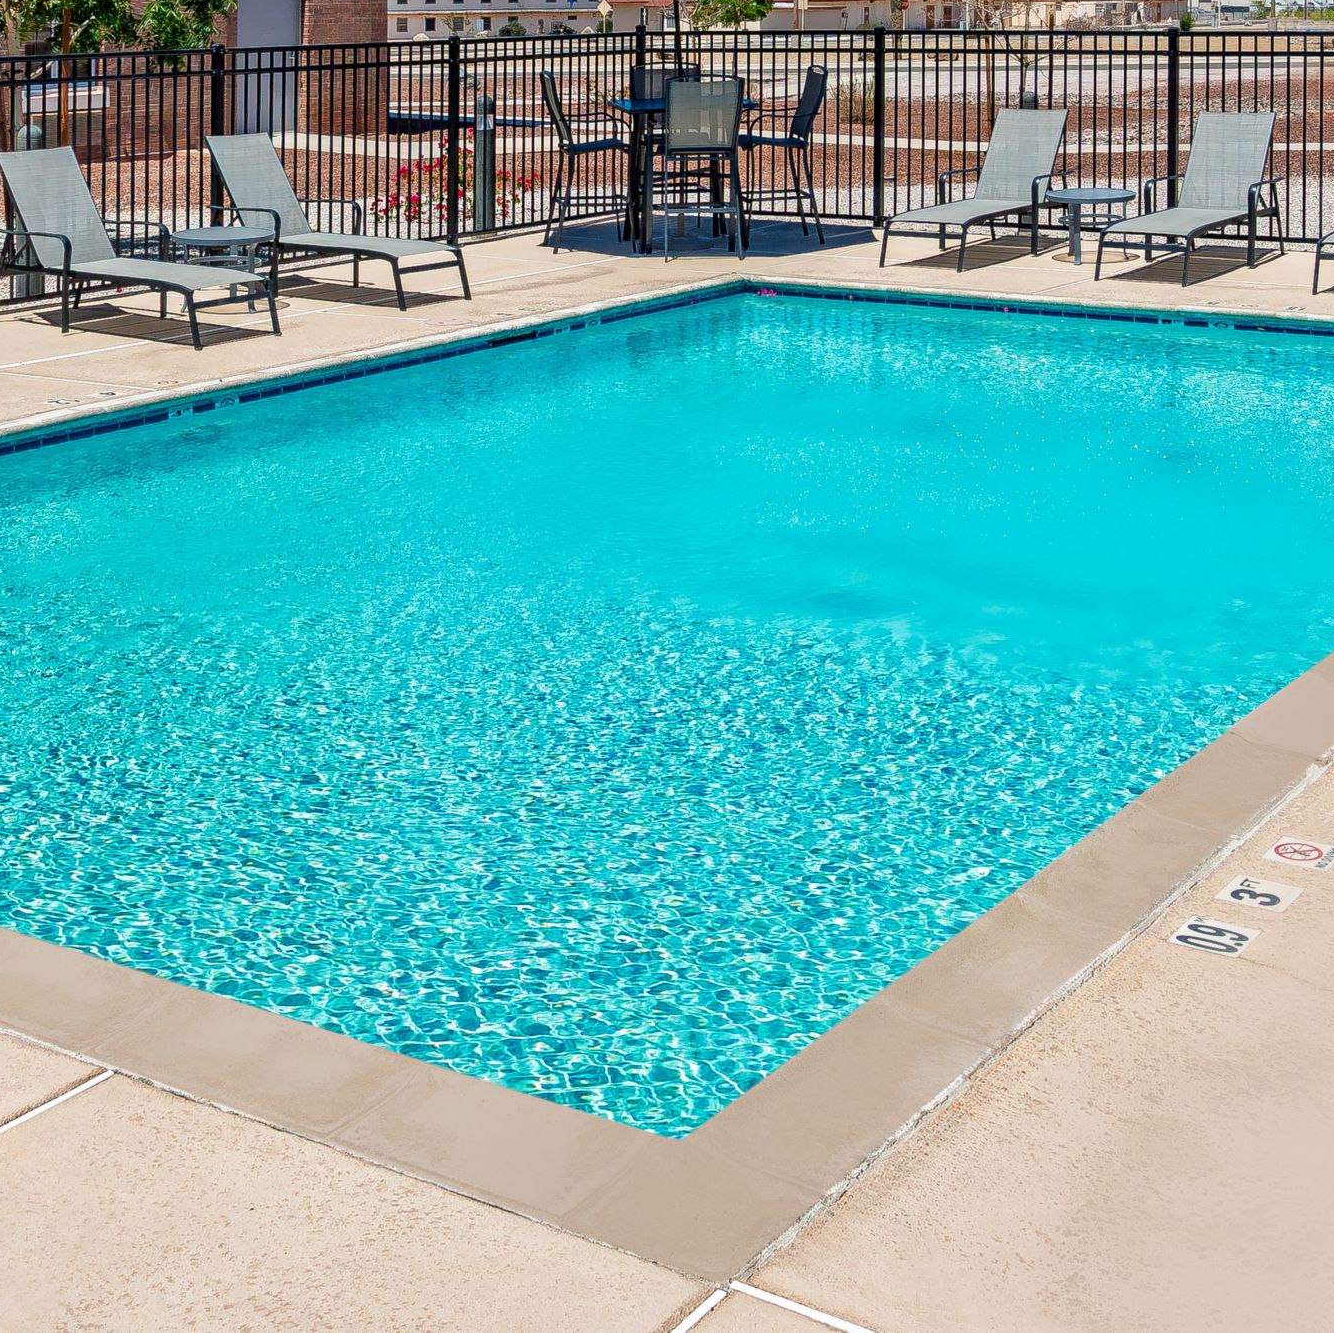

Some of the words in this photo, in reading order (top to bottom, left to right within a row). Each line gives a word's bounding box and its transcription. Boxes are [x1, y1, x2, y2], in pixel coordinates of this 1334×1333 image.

[1239, 878, 1261, 889] FT
[1230, 888, 1281, 906] 3
[1175, 923, 1249, 953] 0.9
